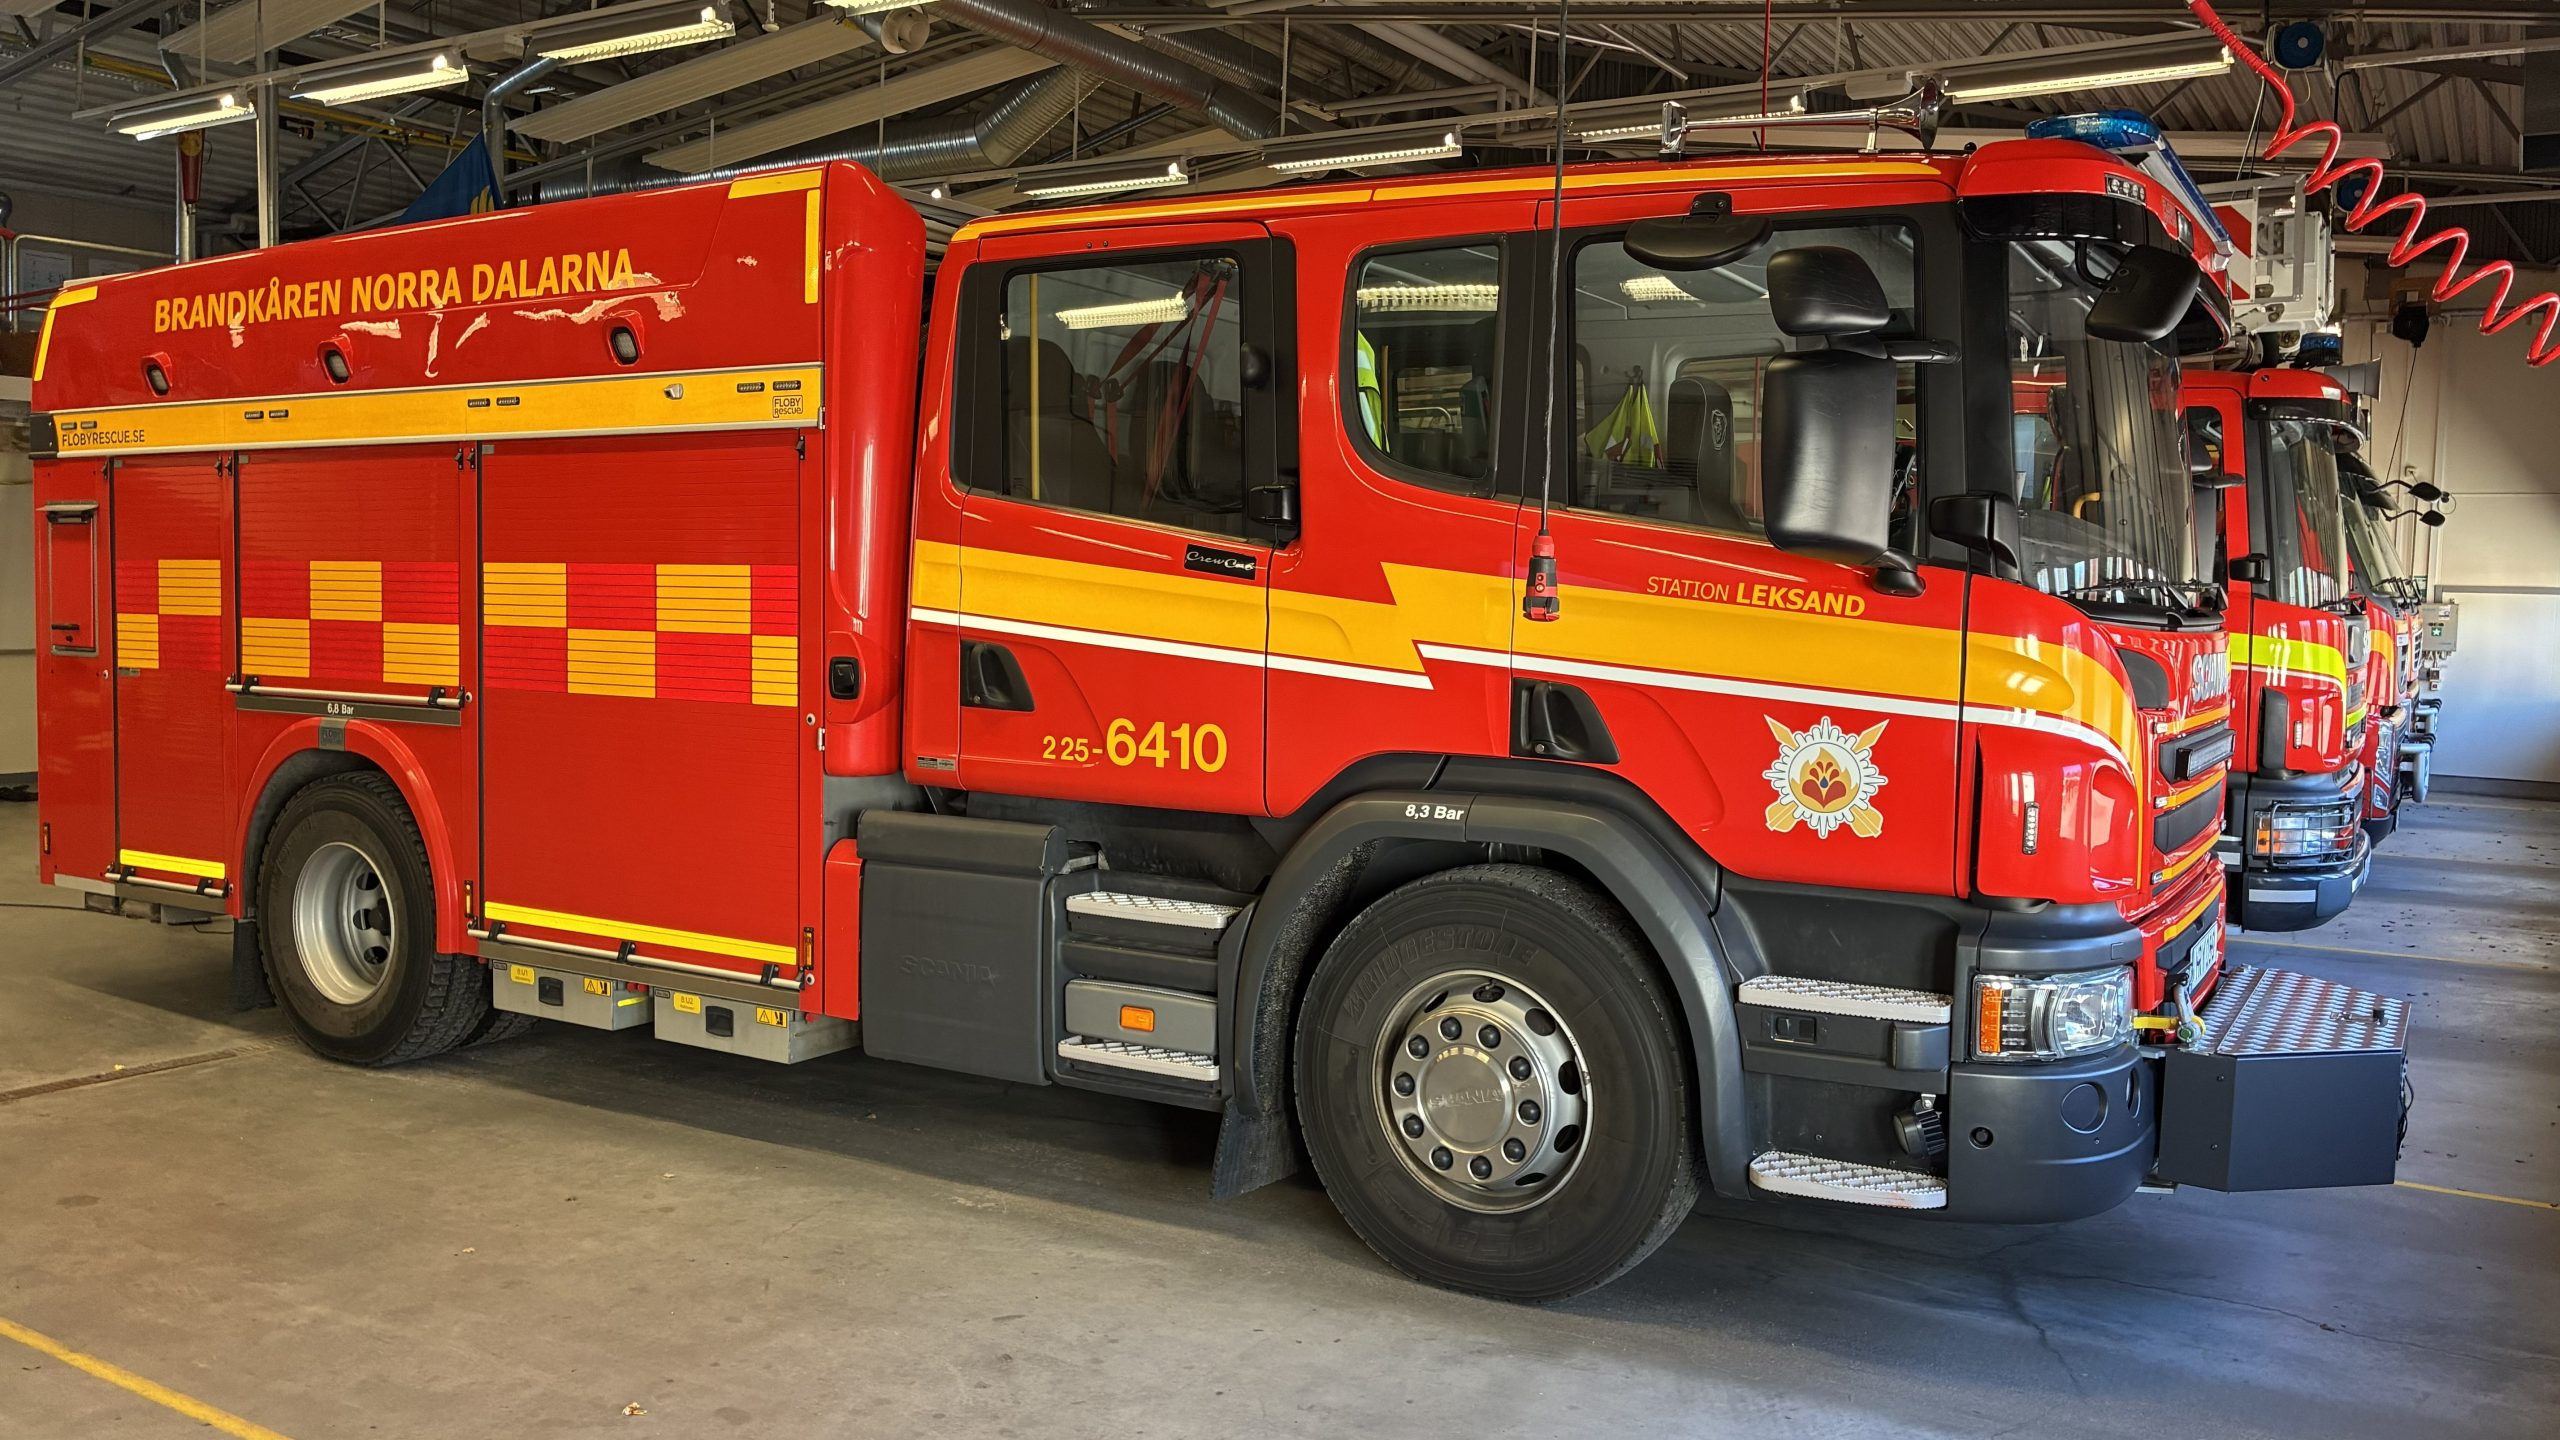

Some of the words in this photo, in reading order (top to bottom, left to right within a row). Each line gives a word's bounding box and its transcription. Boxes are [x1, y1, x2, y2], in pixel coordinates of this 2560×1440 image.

[155, 276, 342, 333] BRANDKÅREN
[351, 267, 463, 313] NORRA
[472, 248, 635, 302] DALARNA
[774, 398, 801, 408] FLOBY
[62, 429, 145, 446] FLOBYRESCUE.SE
[1646, 576, 1729, 602] STATION
[1736, 582, 1866, 617] LEKSAND
[327, 702, 340, 716] 6,8
[341, 703, 354, 715] Bar
[1405, 804, 1430, 820] 8,3
[1434, 805, 1465, 820] Bar
